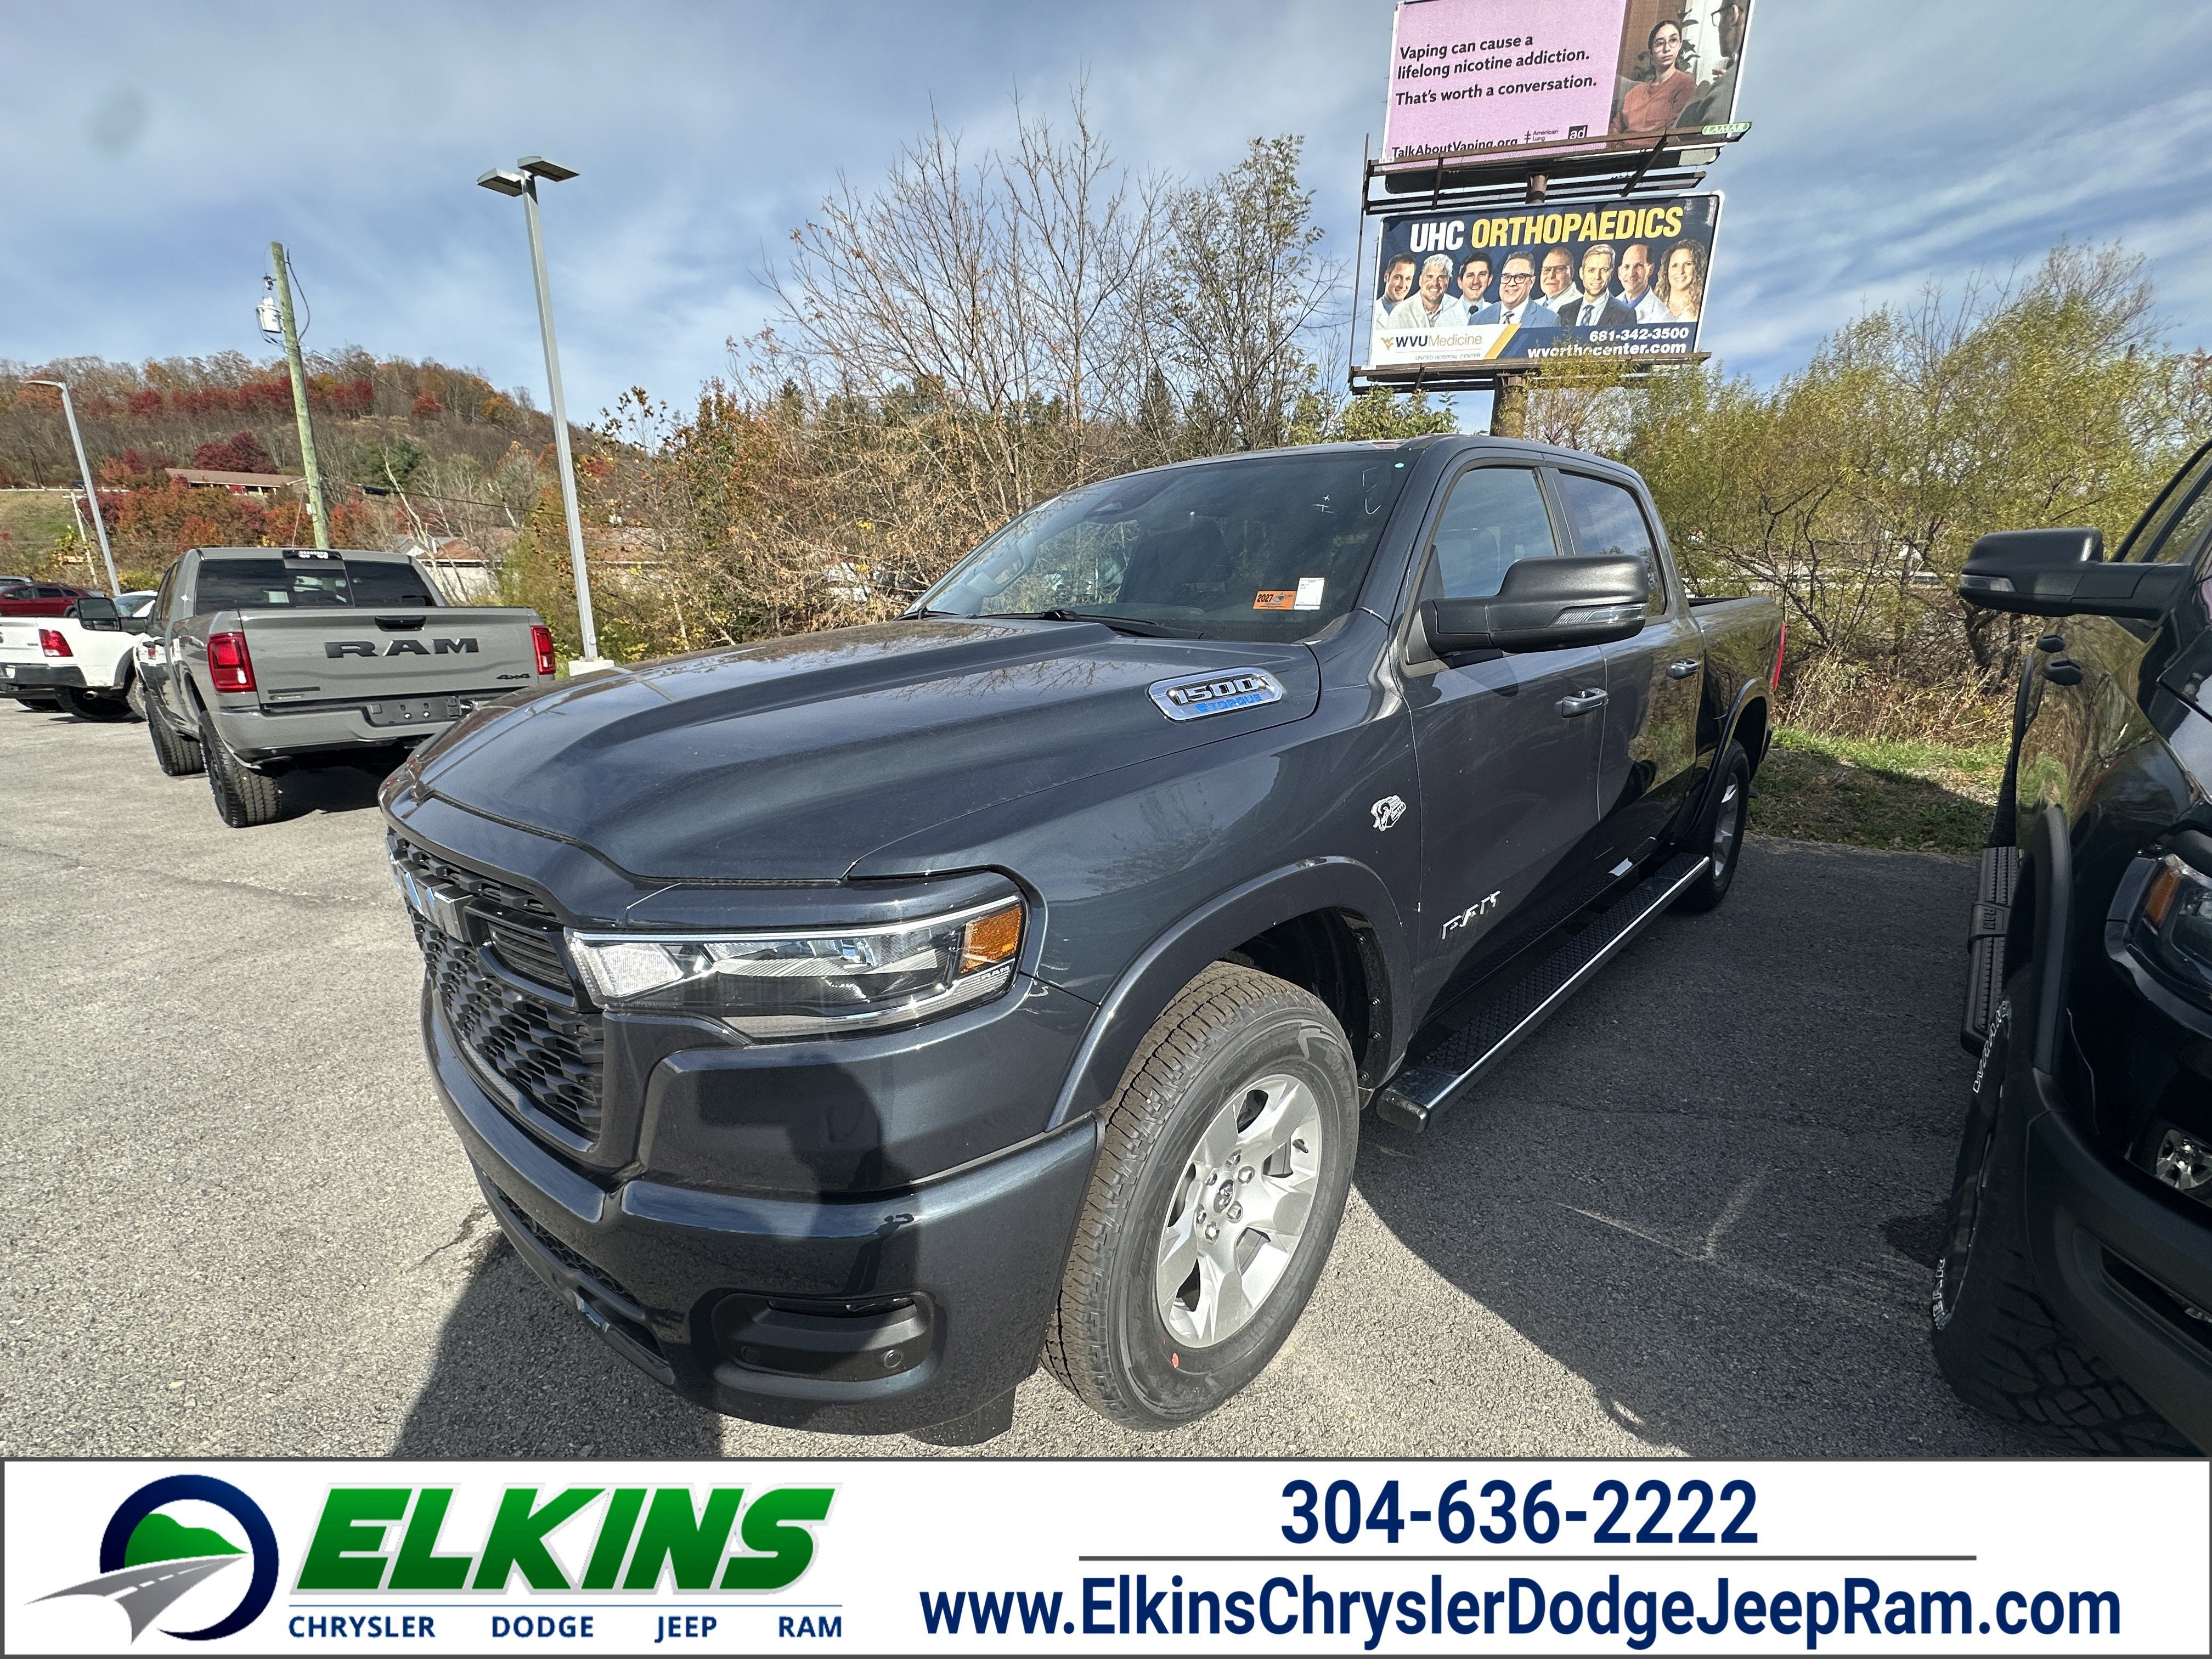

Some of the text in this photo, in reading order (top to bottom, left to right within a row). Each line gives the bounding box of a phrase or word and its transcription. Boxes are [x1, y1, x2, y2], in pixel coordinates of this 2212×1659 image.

[1400, 36, 1533, 61] Vaping can cause a
[1398, 49, 1589, 80] lifelong nicotine addiction.
[1396, 75, 1596, 106] That's worth a conversation.
[1705, 124, 1745, 133] LAMAR
[1410, 207, 1684, 251] UHC ORTHOPAEDICS
[1589, 328, 1689, 342] 681-342-3500
[1256, 594, 1273, 602] 2027
[325, 638, 479, 658] RAM
[1176, 677, 1260, 704] 1500
[981, 966, 1011, 980] RAM
